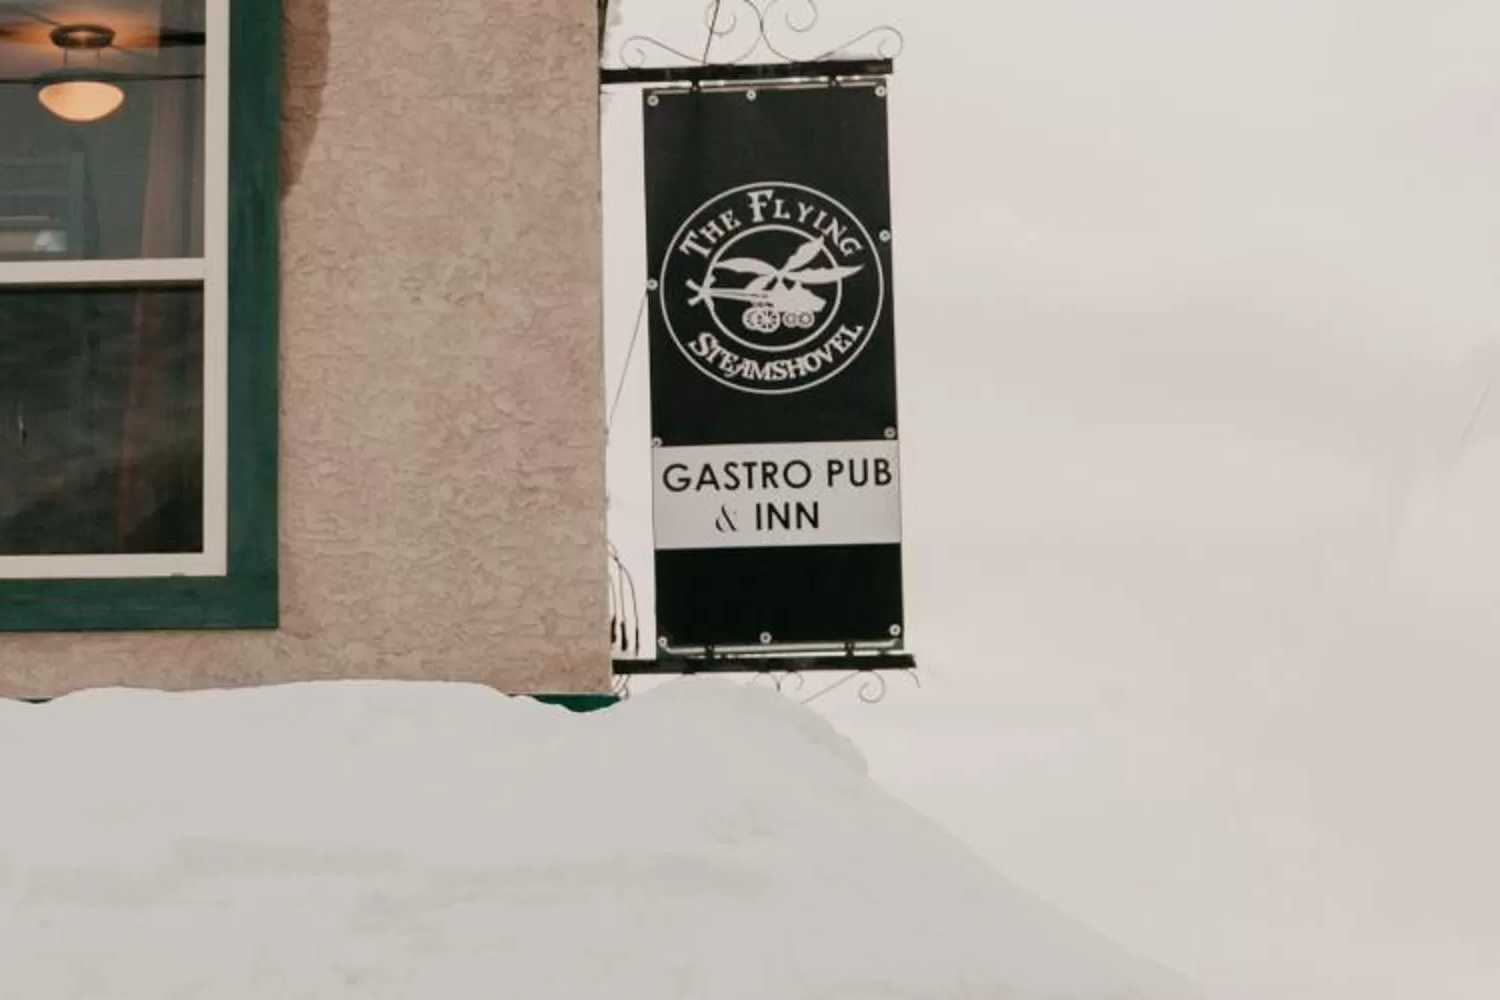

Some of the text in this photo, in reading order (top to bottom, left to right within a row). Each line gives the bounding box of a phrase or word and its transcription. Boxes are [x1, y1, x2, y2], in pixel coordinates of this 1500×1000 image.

[679, 189, 864, 258] THE FLYING
[688, 324, 865, 381] STEAMSHOVEL
[662, 458, 892, 493] GASTRO PUB
[715, 501, 820, 533] & INN
